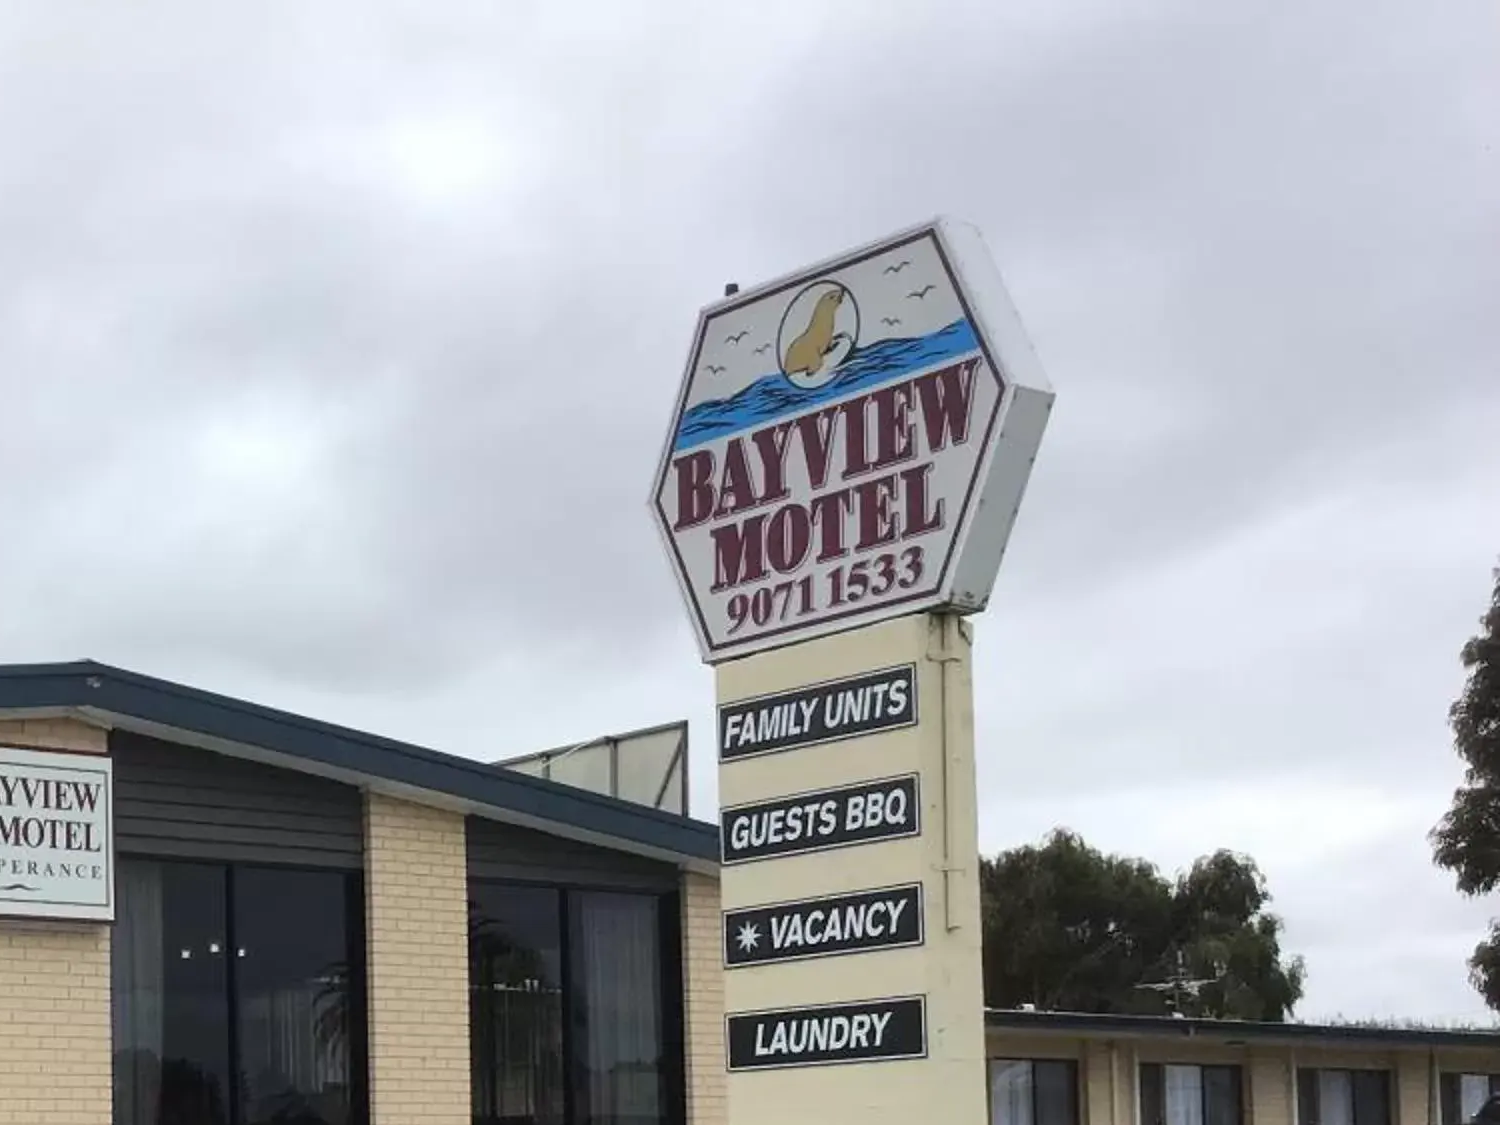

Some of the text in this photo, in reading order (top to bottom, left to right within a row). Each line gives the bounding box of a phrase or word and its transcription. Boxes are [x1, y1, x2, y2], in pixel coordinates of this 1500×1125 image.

[673, 356, 982, 532] BAYVIEW
[710, 462, 945, 593] MOTEL
[727, 545, 924, 634] 9071 1533
[724, 678, 908, 749] FAMILY UNITS
[731, 788, 907, 850] GUESTS BBQ
[770, 899, 908, 950] VACANCY
[755, 1012, 892, 1056] LAUNDRY
